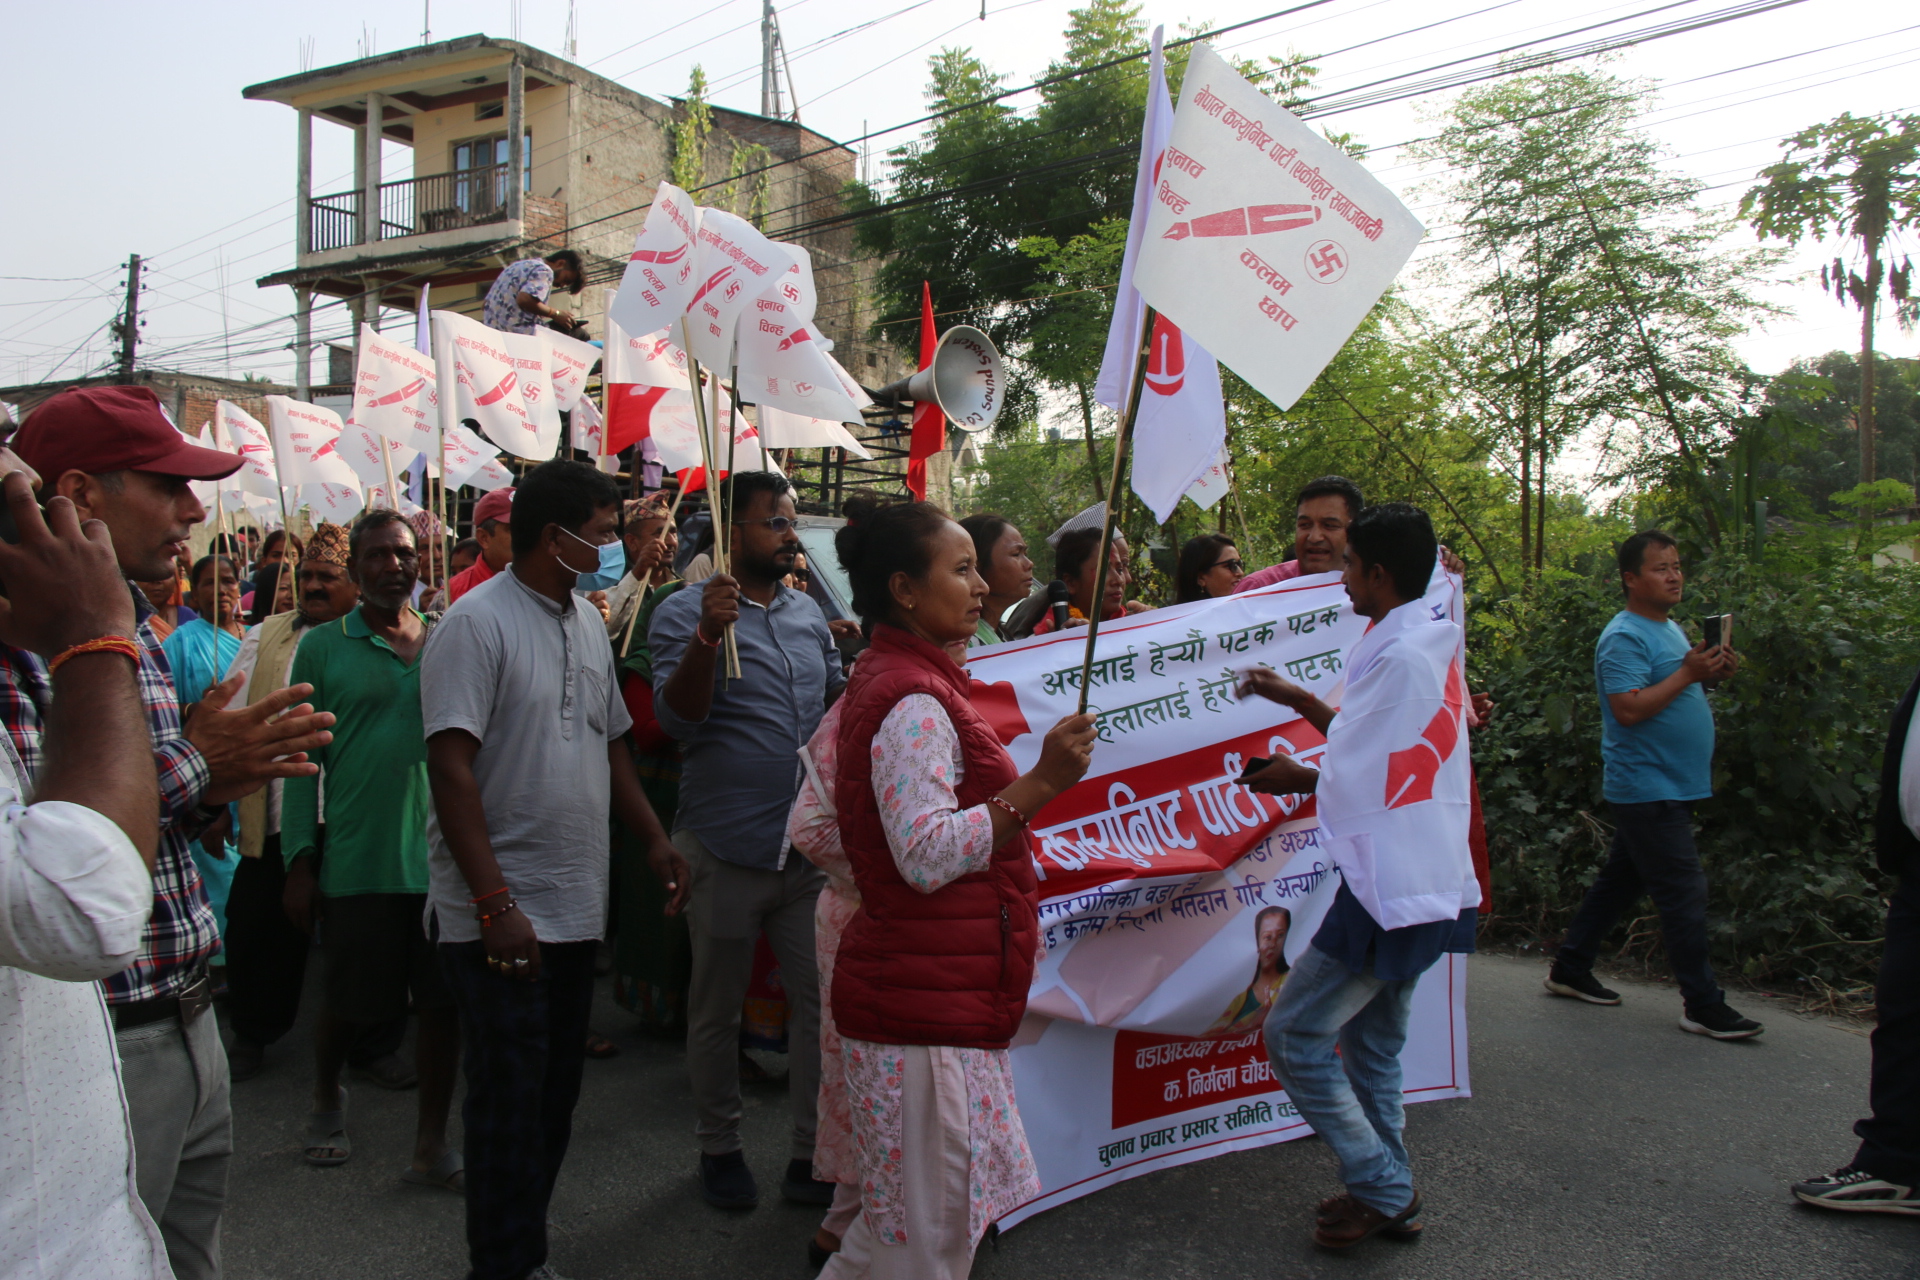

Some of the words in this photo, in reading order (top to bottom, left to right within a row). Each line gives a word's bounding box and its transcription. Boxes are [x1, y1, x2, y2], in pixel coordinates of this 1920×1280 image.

[1193, 84, 1227, 118] नेपाल
[1221, 107, 1274, 151] कम्युनिष्ट
[1268, 142, 1299, 169] पार्टी
[1167, 145, 1206, 179] चुनाव
[1157, 179, 1191, 215] चिन्ह
[641, 268, 667, 292] कलम
[1240, 247, 1294, 296] कलम
[641, 289, 662, 307] छाप
[702, 301, 720, 320] कलम
[756, 298, 786, 313] चुनाव
[1258, 295, 1299, 332] छाप
[758, 318, 786, 336] चिन्ह
[975, 369, 996, 411] Sound
[401, 404, 427, 420] कलम
[1217, 620, 1277, 654] पटक
[1286, 603, 1342, 635] पटक
[1087, 681, 1193, 744] हिलालाई
[1284, 648, 1342, 683] पटक
[1033, 781, 1198, 871] कम्युनिष्ट
[1187, 752, 1270, 837] पार्टी
[1145, 883, 1182, 904] वडा
[1278, 827, 1321, 854] अध्य
[1170, 889, 1227, 919] मतदान
[1233, 874, 1270, 906] गरि
[1187, 1064, 1238, 1098] निर्मला
[1098, 1137, 1136, 1167] चुनाव
[1140, 1126, 1178, 1153] प्रचार
[1181, 1116, 1220, 1142] प्रसार
[1224, 1101, 1273, 1131] समिति
